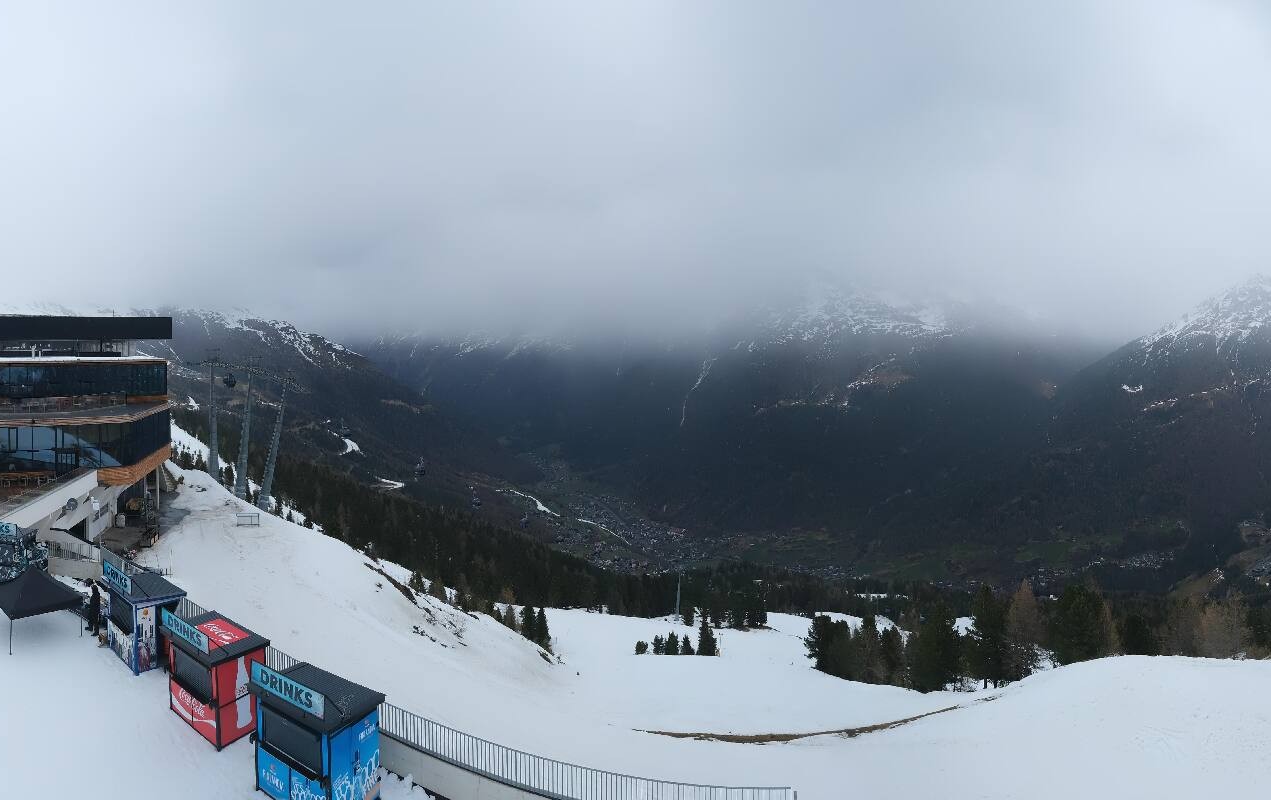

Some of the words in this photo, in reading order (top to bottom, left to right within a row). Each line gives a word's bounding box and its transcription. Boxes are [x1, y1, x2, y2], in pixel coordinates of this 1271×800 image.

[107, 566, 128, 589] DRINKS
[168, 615, 202, 646] DRINKS
[260, 668, 313, 709] DRINKS
